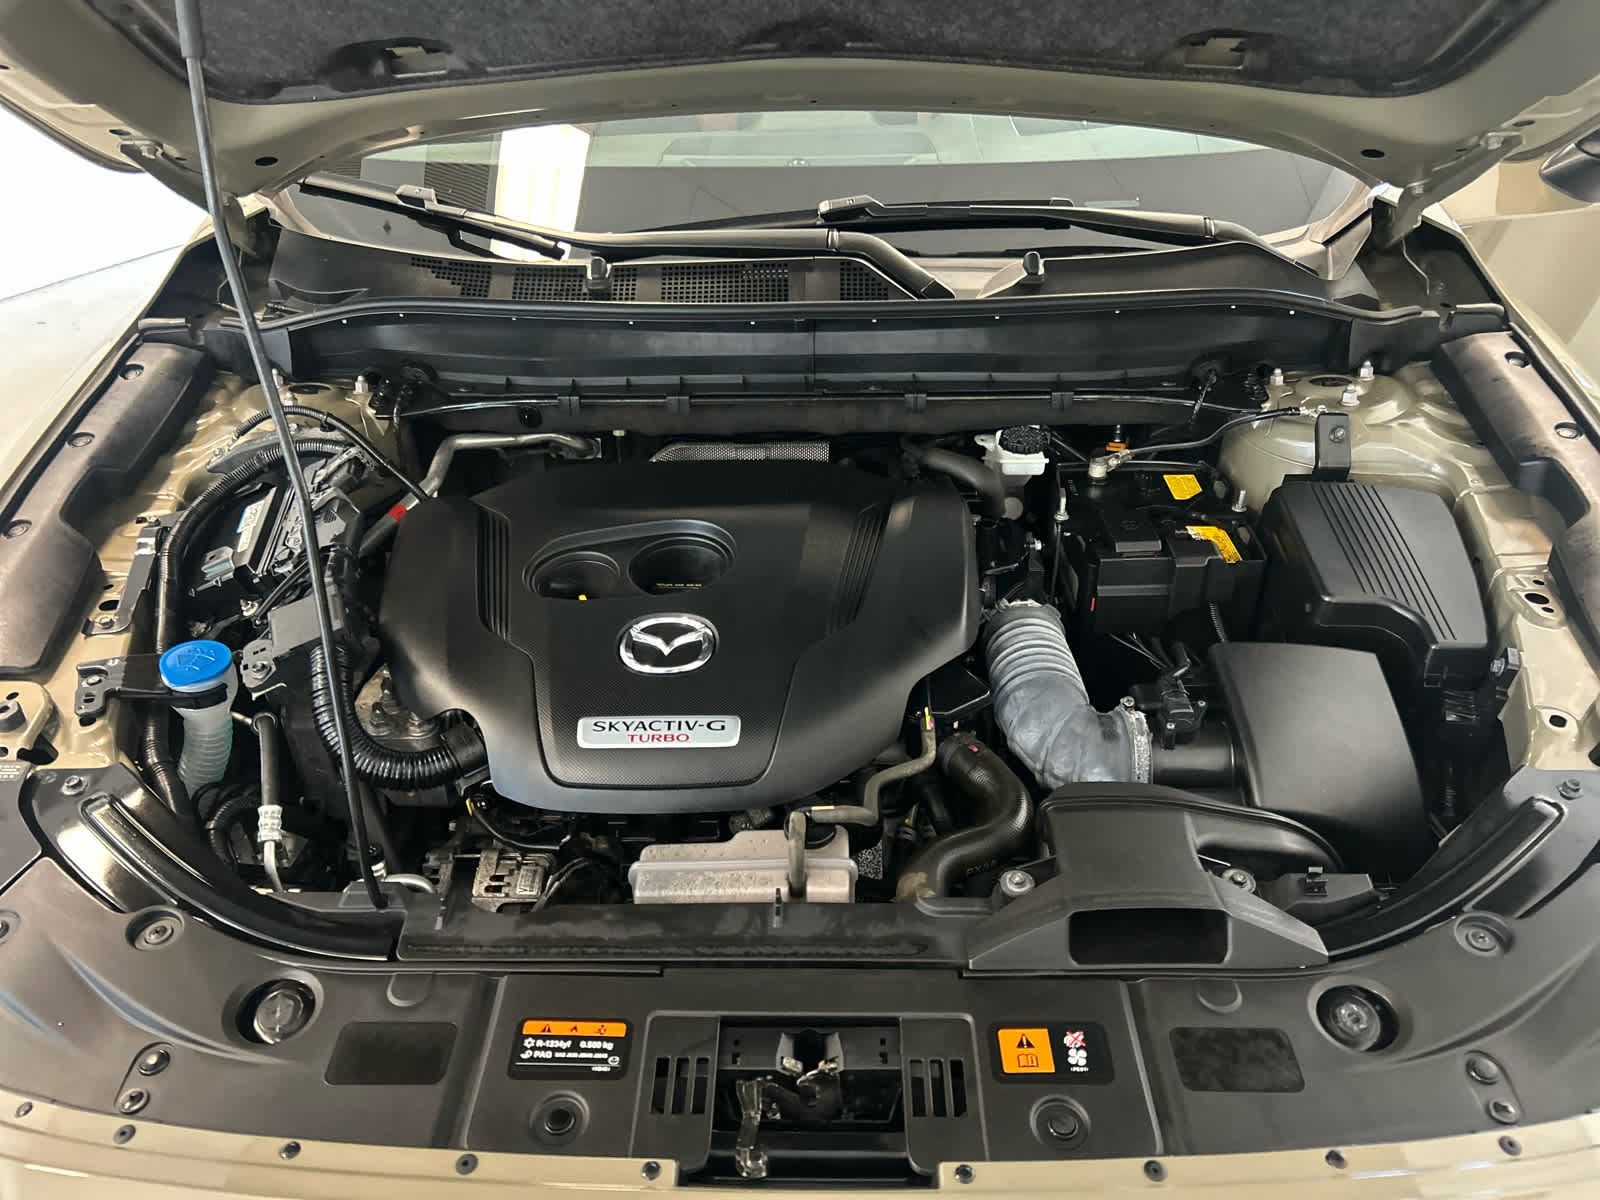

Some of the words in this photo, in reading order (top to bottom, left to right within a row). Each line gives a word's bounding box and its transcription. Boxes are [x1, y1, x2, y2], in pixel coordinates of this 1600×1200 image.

[592, 720, 726, 732] SKYACTIV-G
[628, 733, 690, 743] TURBO
[602, 1041, 614, 1051] kg
